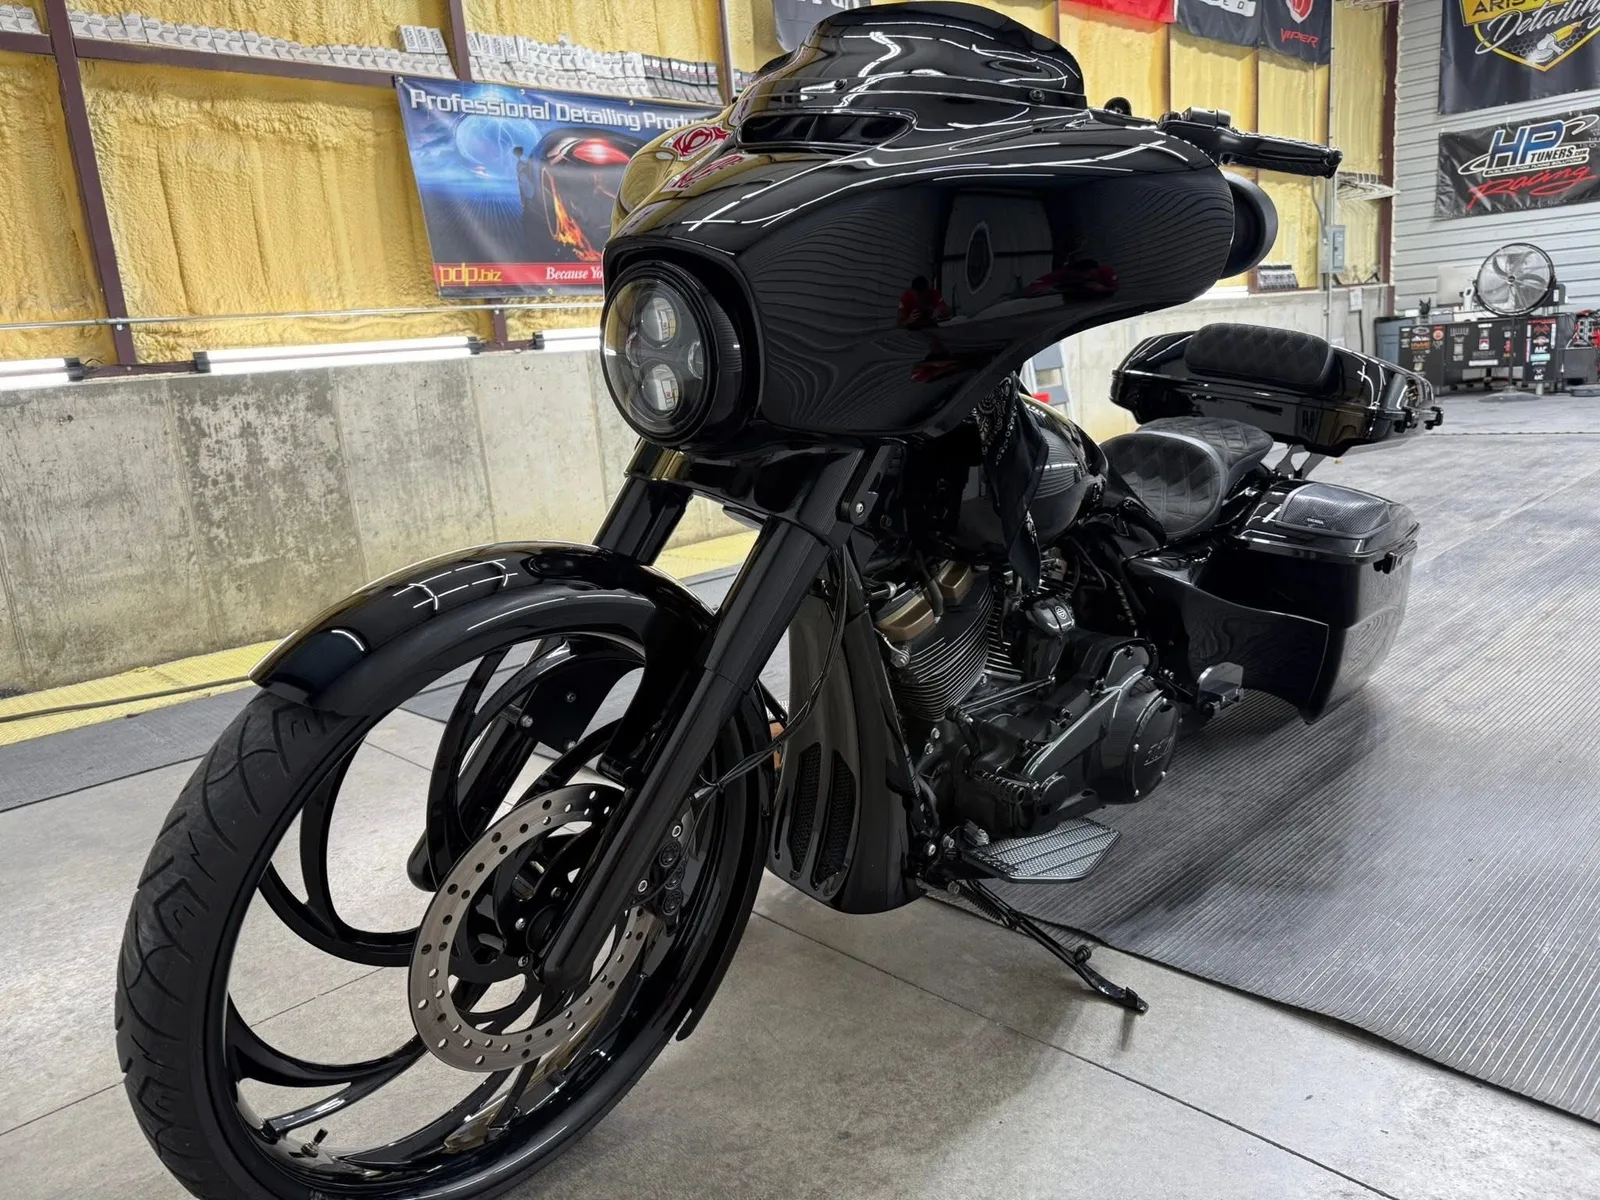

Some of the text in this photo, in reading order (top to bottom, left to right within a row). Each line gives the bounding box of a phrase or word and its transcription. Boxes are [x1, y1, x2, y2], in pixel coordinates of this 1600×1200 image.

[1281, 28, 1319, 48] VIPER
[409, 88, 550, 120] Professional
[555, 102, 641, 132] Detailing
[1486, 120, 1565, 169] HP
[1466, 166, 1597, 211] Racing
[439, 262, 502, 287] pdp.biz
[546, 266, 588, 280] Because
